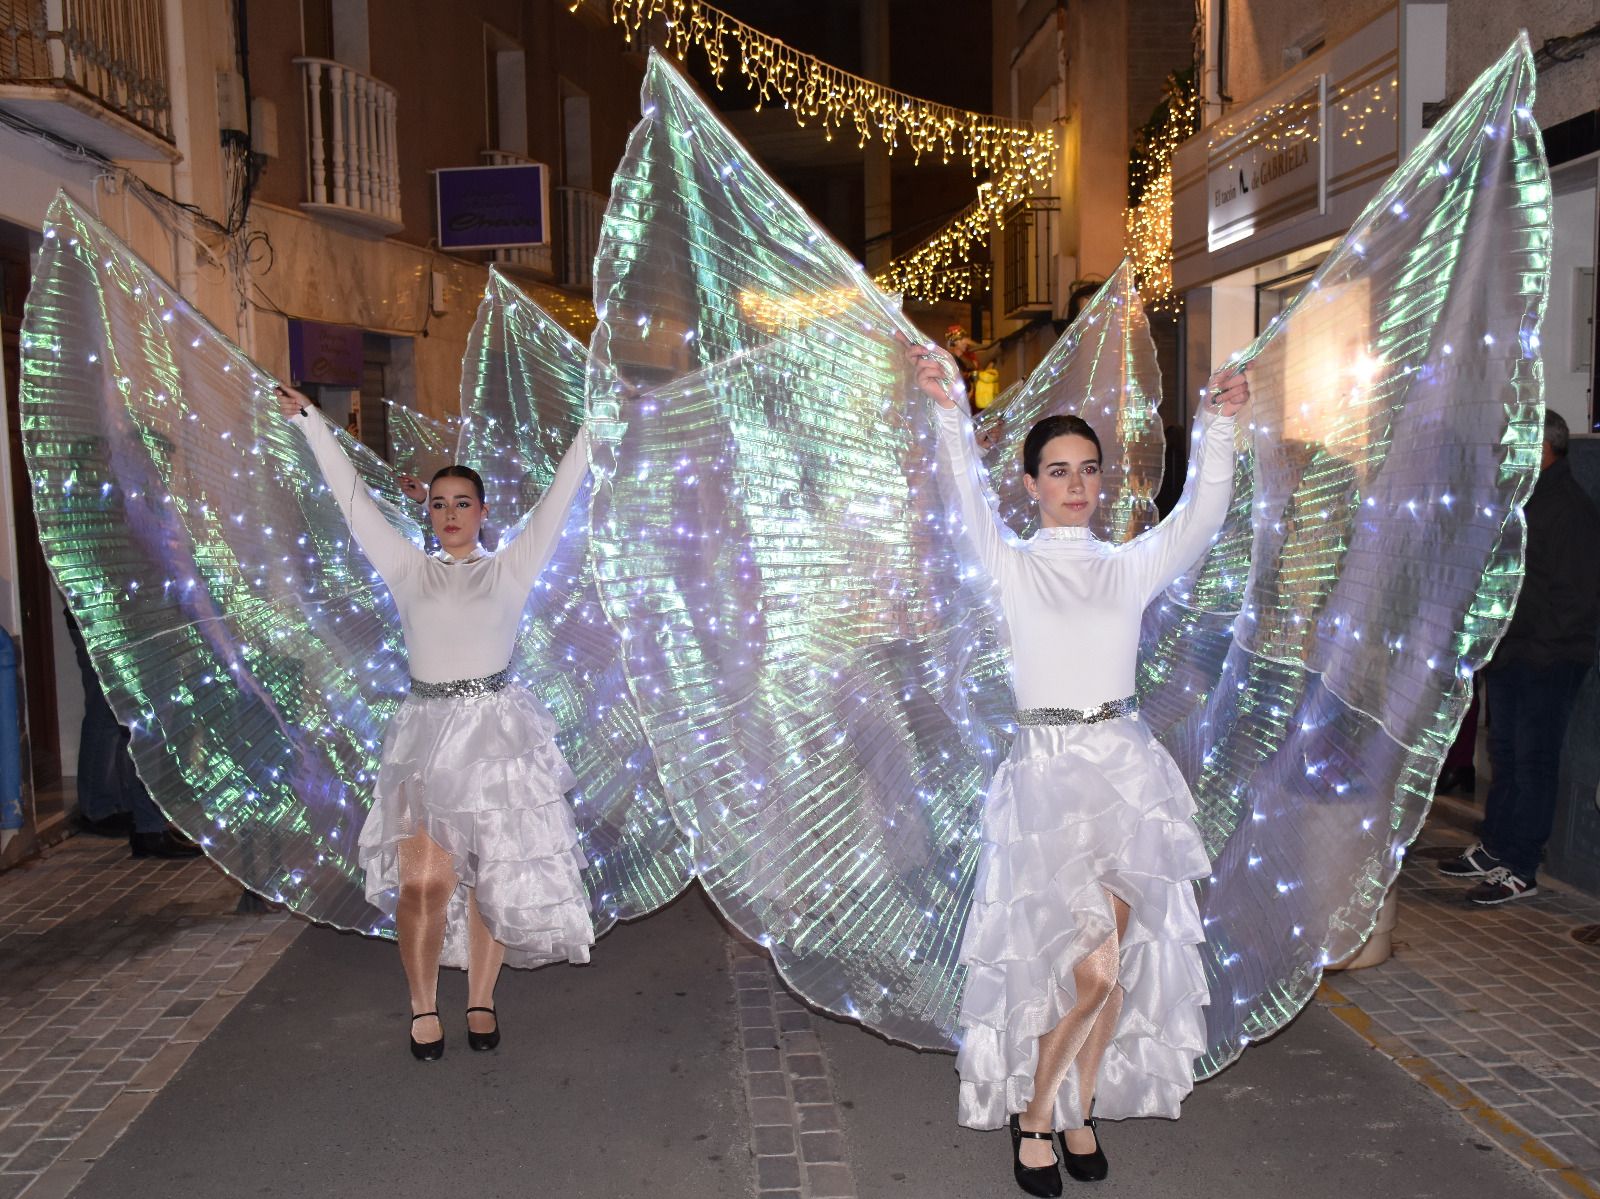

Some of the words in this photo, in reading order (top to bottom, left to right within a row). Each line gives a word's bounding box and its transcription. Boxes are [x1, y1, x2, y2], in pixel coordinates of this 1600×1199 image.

[1215, 189, 1221, 207] El
[1251, 170, 1260, 190] de
[1260, 143, 1308, 185] GABRIELA
